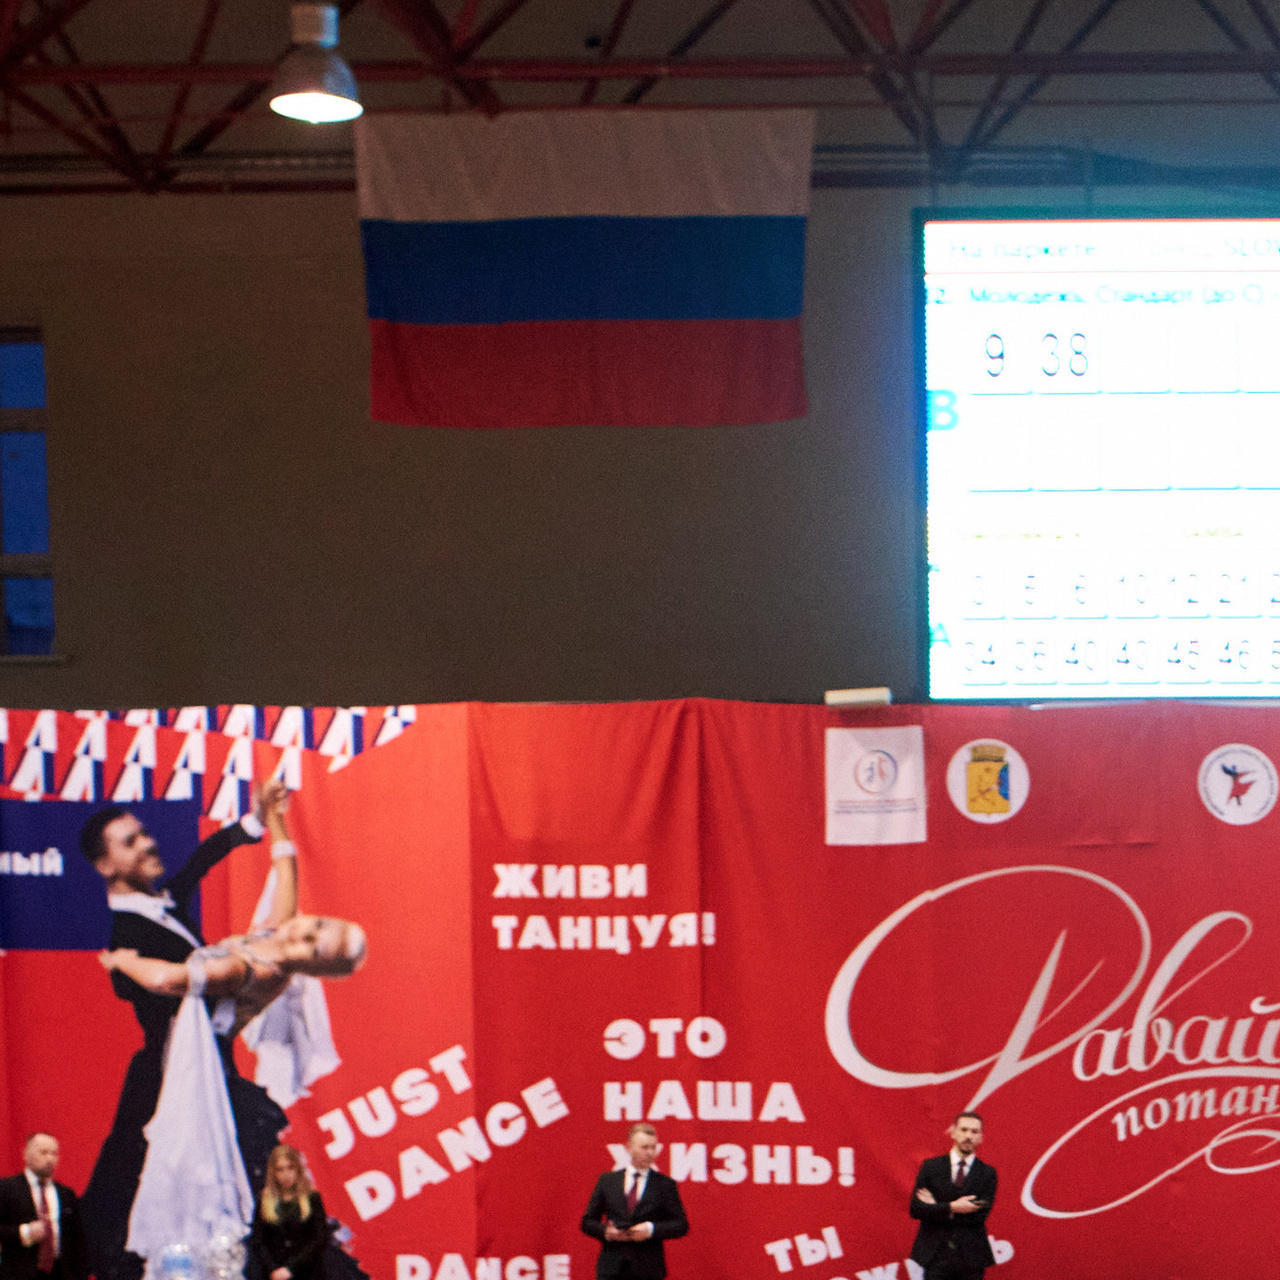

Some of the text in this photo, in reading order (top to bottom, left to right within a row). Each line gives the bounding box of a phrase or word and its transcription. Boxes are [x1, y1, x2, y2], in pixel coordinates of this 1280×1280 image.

[985, 332, 1088, 377] 9 38
[1166, 640, 1200, 670] 45
[1218, 640, 1250, 670] 46
[492, 863, 648, 898] ЖИВИ
[491, 912, 716, 955] ТАНЦУЯ!
[603, 1016, 728, 1060] ЭТО
[316, 1044, 473, 1161] JUST
[603, 1080, 807, 1123] НАША
[344, 1077, 570, 1223] DANCE
[764, 1226, 843, 1273] ТЫ
